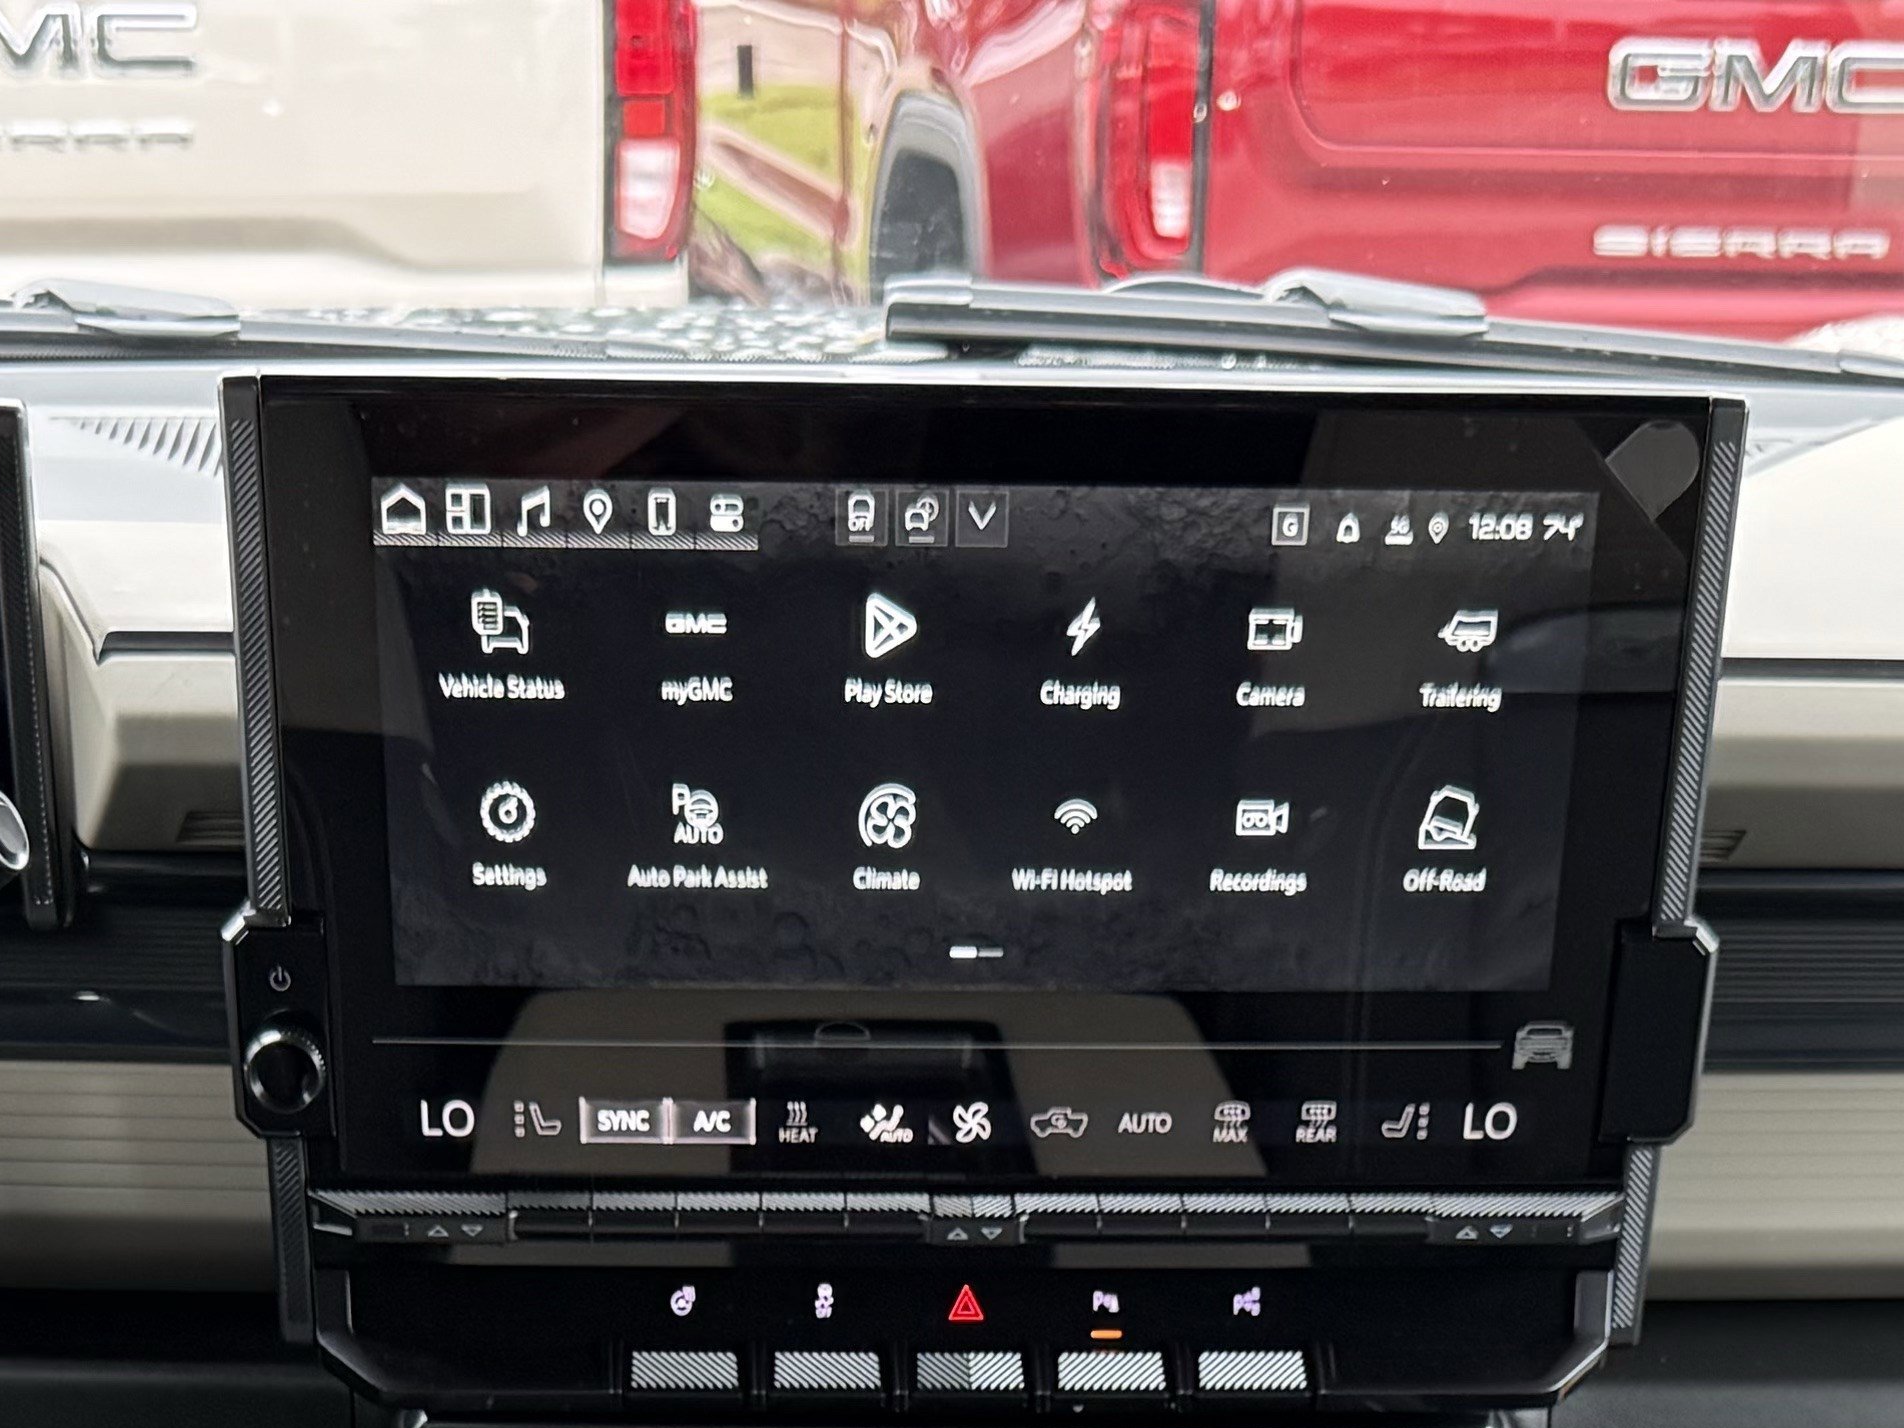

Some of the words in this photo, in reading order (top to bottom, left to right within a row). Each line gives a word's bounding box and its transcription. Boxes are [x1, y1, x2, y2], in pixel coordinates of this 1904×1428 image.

[1593, 224, 1890, 261] SIERRA
[1469, 514, 1533, 540] 12:08
[439, 673, 504, 698] Vehicle
[507, 675, 565, 699] Status
[662, 677, 733, 705] myGMC
[845, 678, 882, 708] Play
[885, 679, 933, 703] Store
[1040, 680, 1120, 710] Charging
[1236, 682, 1305, 706] Camera
[1420, 683, 1501, 712] Trailering
[674, 821, 723, 844] AUTO
[473, 862, 547, 890] Settings
[628, 865, 670, 887] Auto
[673, 865, 712, 888] Park
[714, 866, 768, 888] Assist
[853, 867, 920, 890] Climate
[1012, 868, 1058, 890] Wi-Fi
[1060, 869, 1132, 895] Hotspot
[1210, 869, 1307, 896] Recordings
[1403, 868, 1486, 892] Off-Road
[421, 1100, 474, 1137] LO
[598, 1110, 649, 1131] SYNC
[694, 1111, 731, 1132] A/C
[1118, 1113, 1172, 1133] AUTO
[1464, 1103, 1517, 1139] LO
[779, 1128, 818, 1143] HEAT
[880, 1128, 915, 1146] AUTO
[1213, 1126, 1247, 1142] MAX
[1296, 1126, 1336, 1142] REAR
